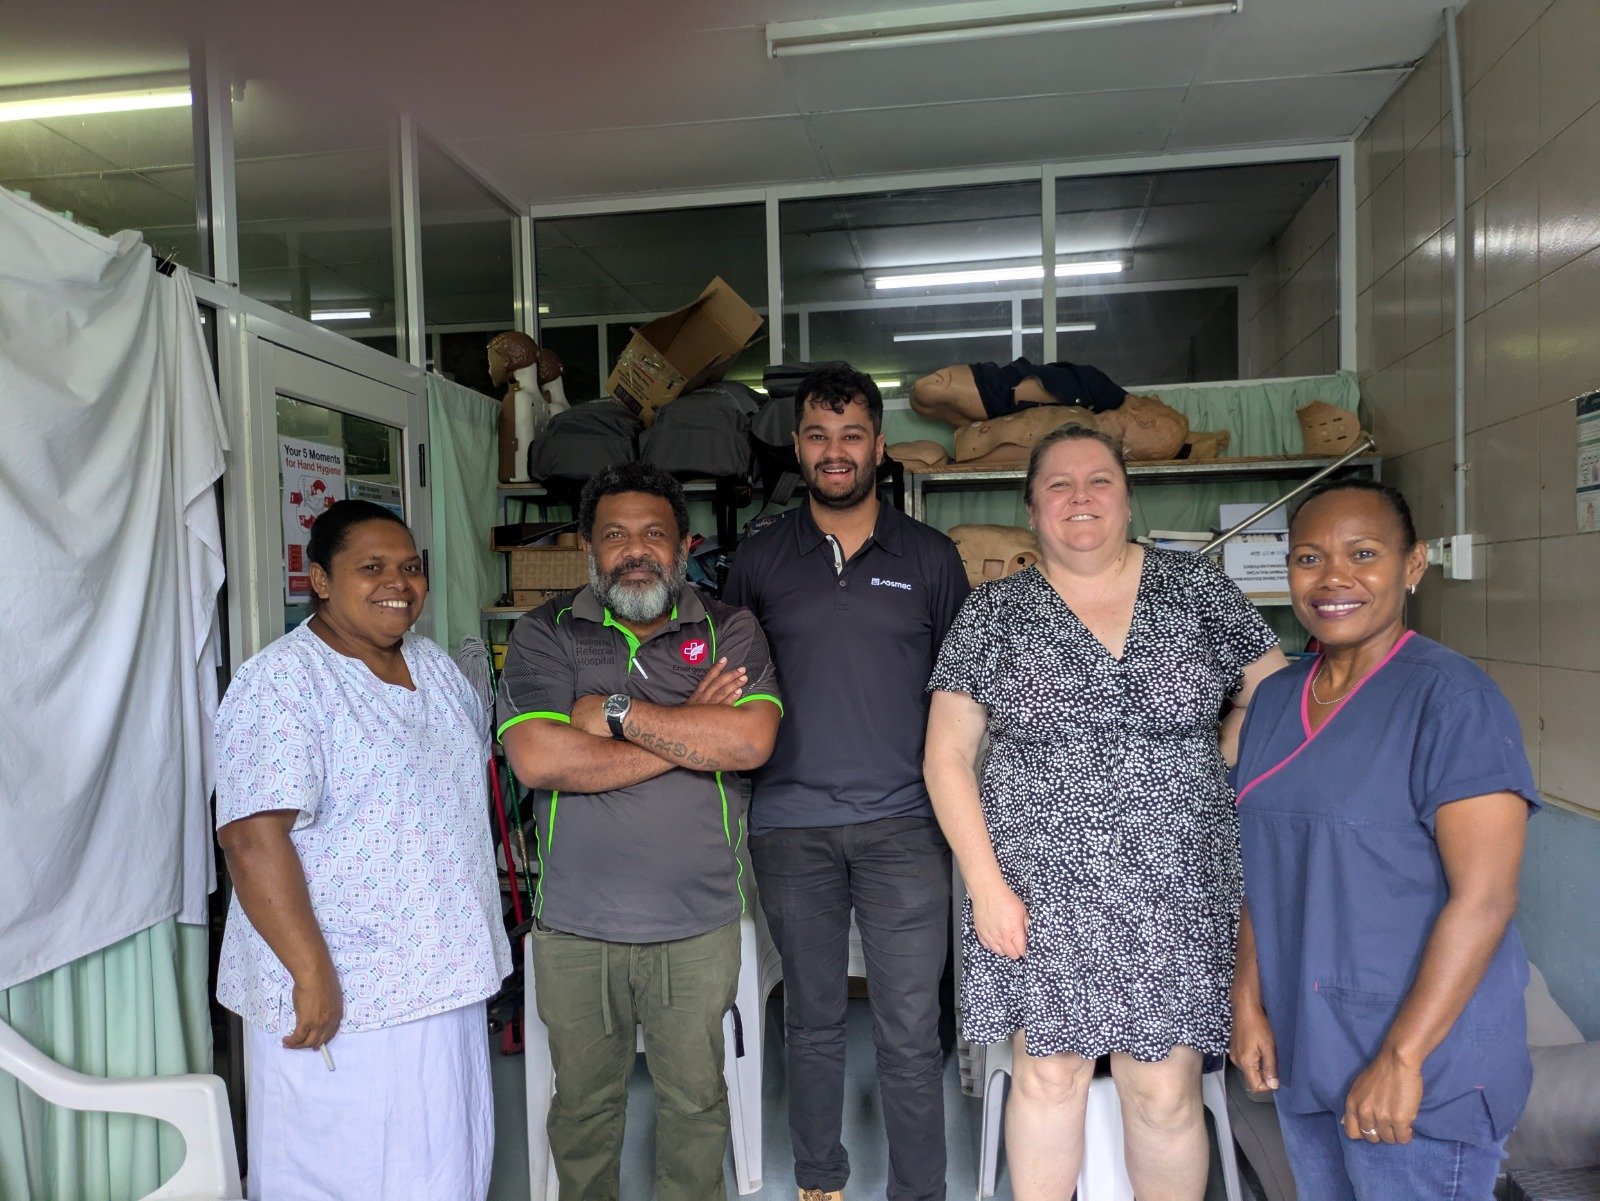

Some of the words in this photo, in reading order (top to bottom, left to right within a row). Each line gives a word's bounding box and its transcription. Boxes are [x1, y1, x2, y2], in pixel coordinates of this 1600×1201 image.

[284, 444, 301, 456] Your
[303, 448, 308, 458] 5
[310, 449, 341, 464] Moments
[286, 457, 296, 468] for
[298, 459, 315, 471] Hand
[316, 463, 342, 475] Hygiene
[576, 638, 611, 647] National
[576, 646, 614, 656] Referral
[577, 656, 615, 667] Hospital
